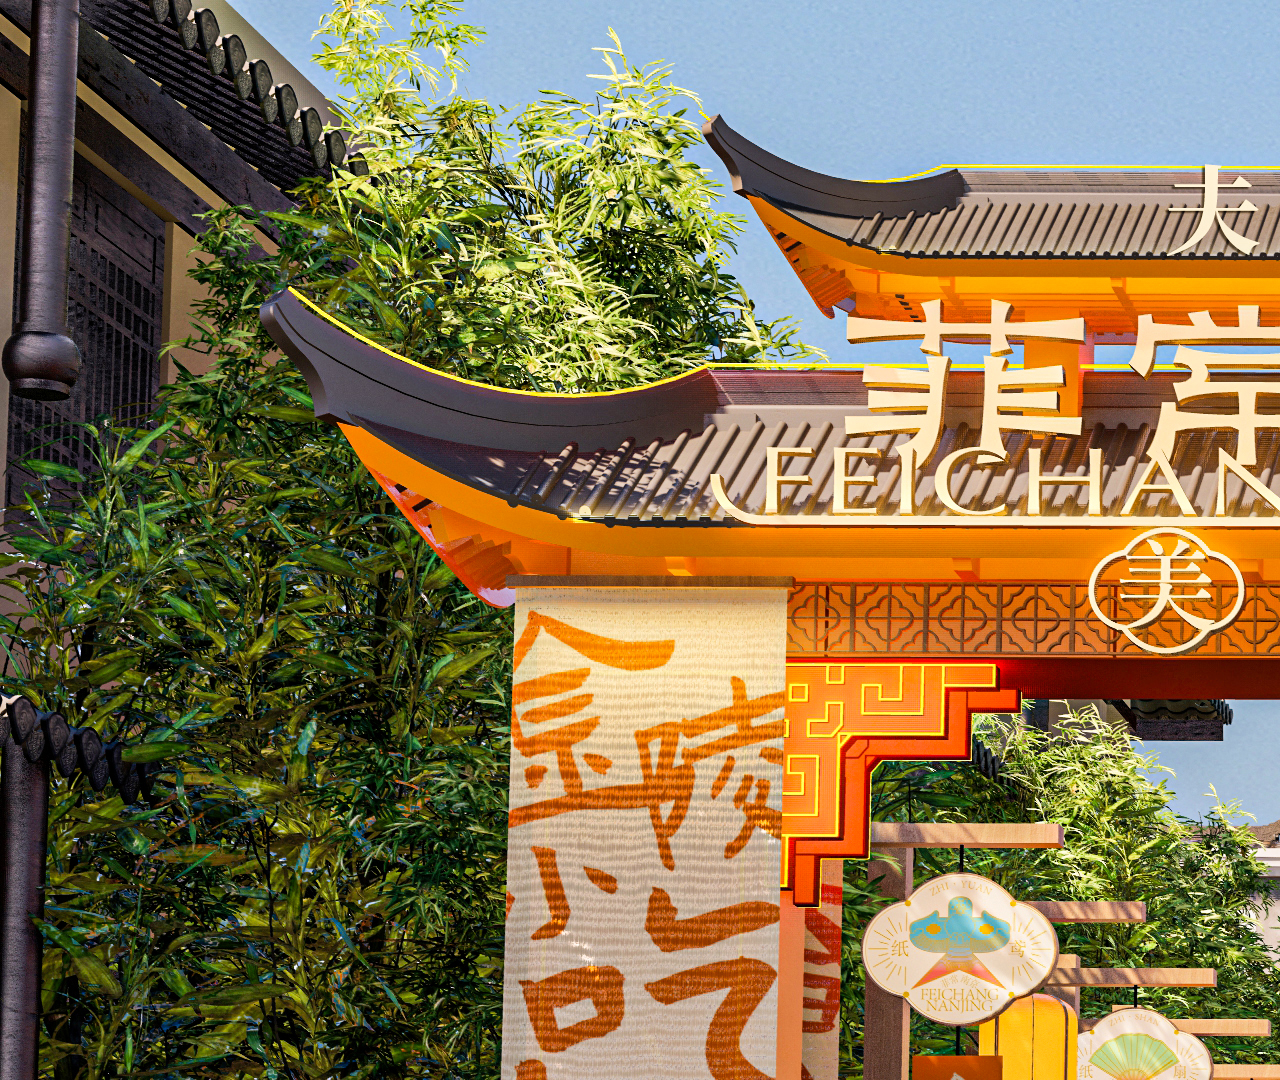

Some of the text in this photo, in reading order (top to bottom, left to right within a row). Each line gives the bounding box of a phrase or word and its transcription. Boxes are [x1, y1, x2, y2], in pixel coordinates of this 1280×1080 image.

[891, 940, 909, 958] 纸
[921, 988, 999, 1001] FEICHANG
[926, 1000, 993, 1013] NANJING
